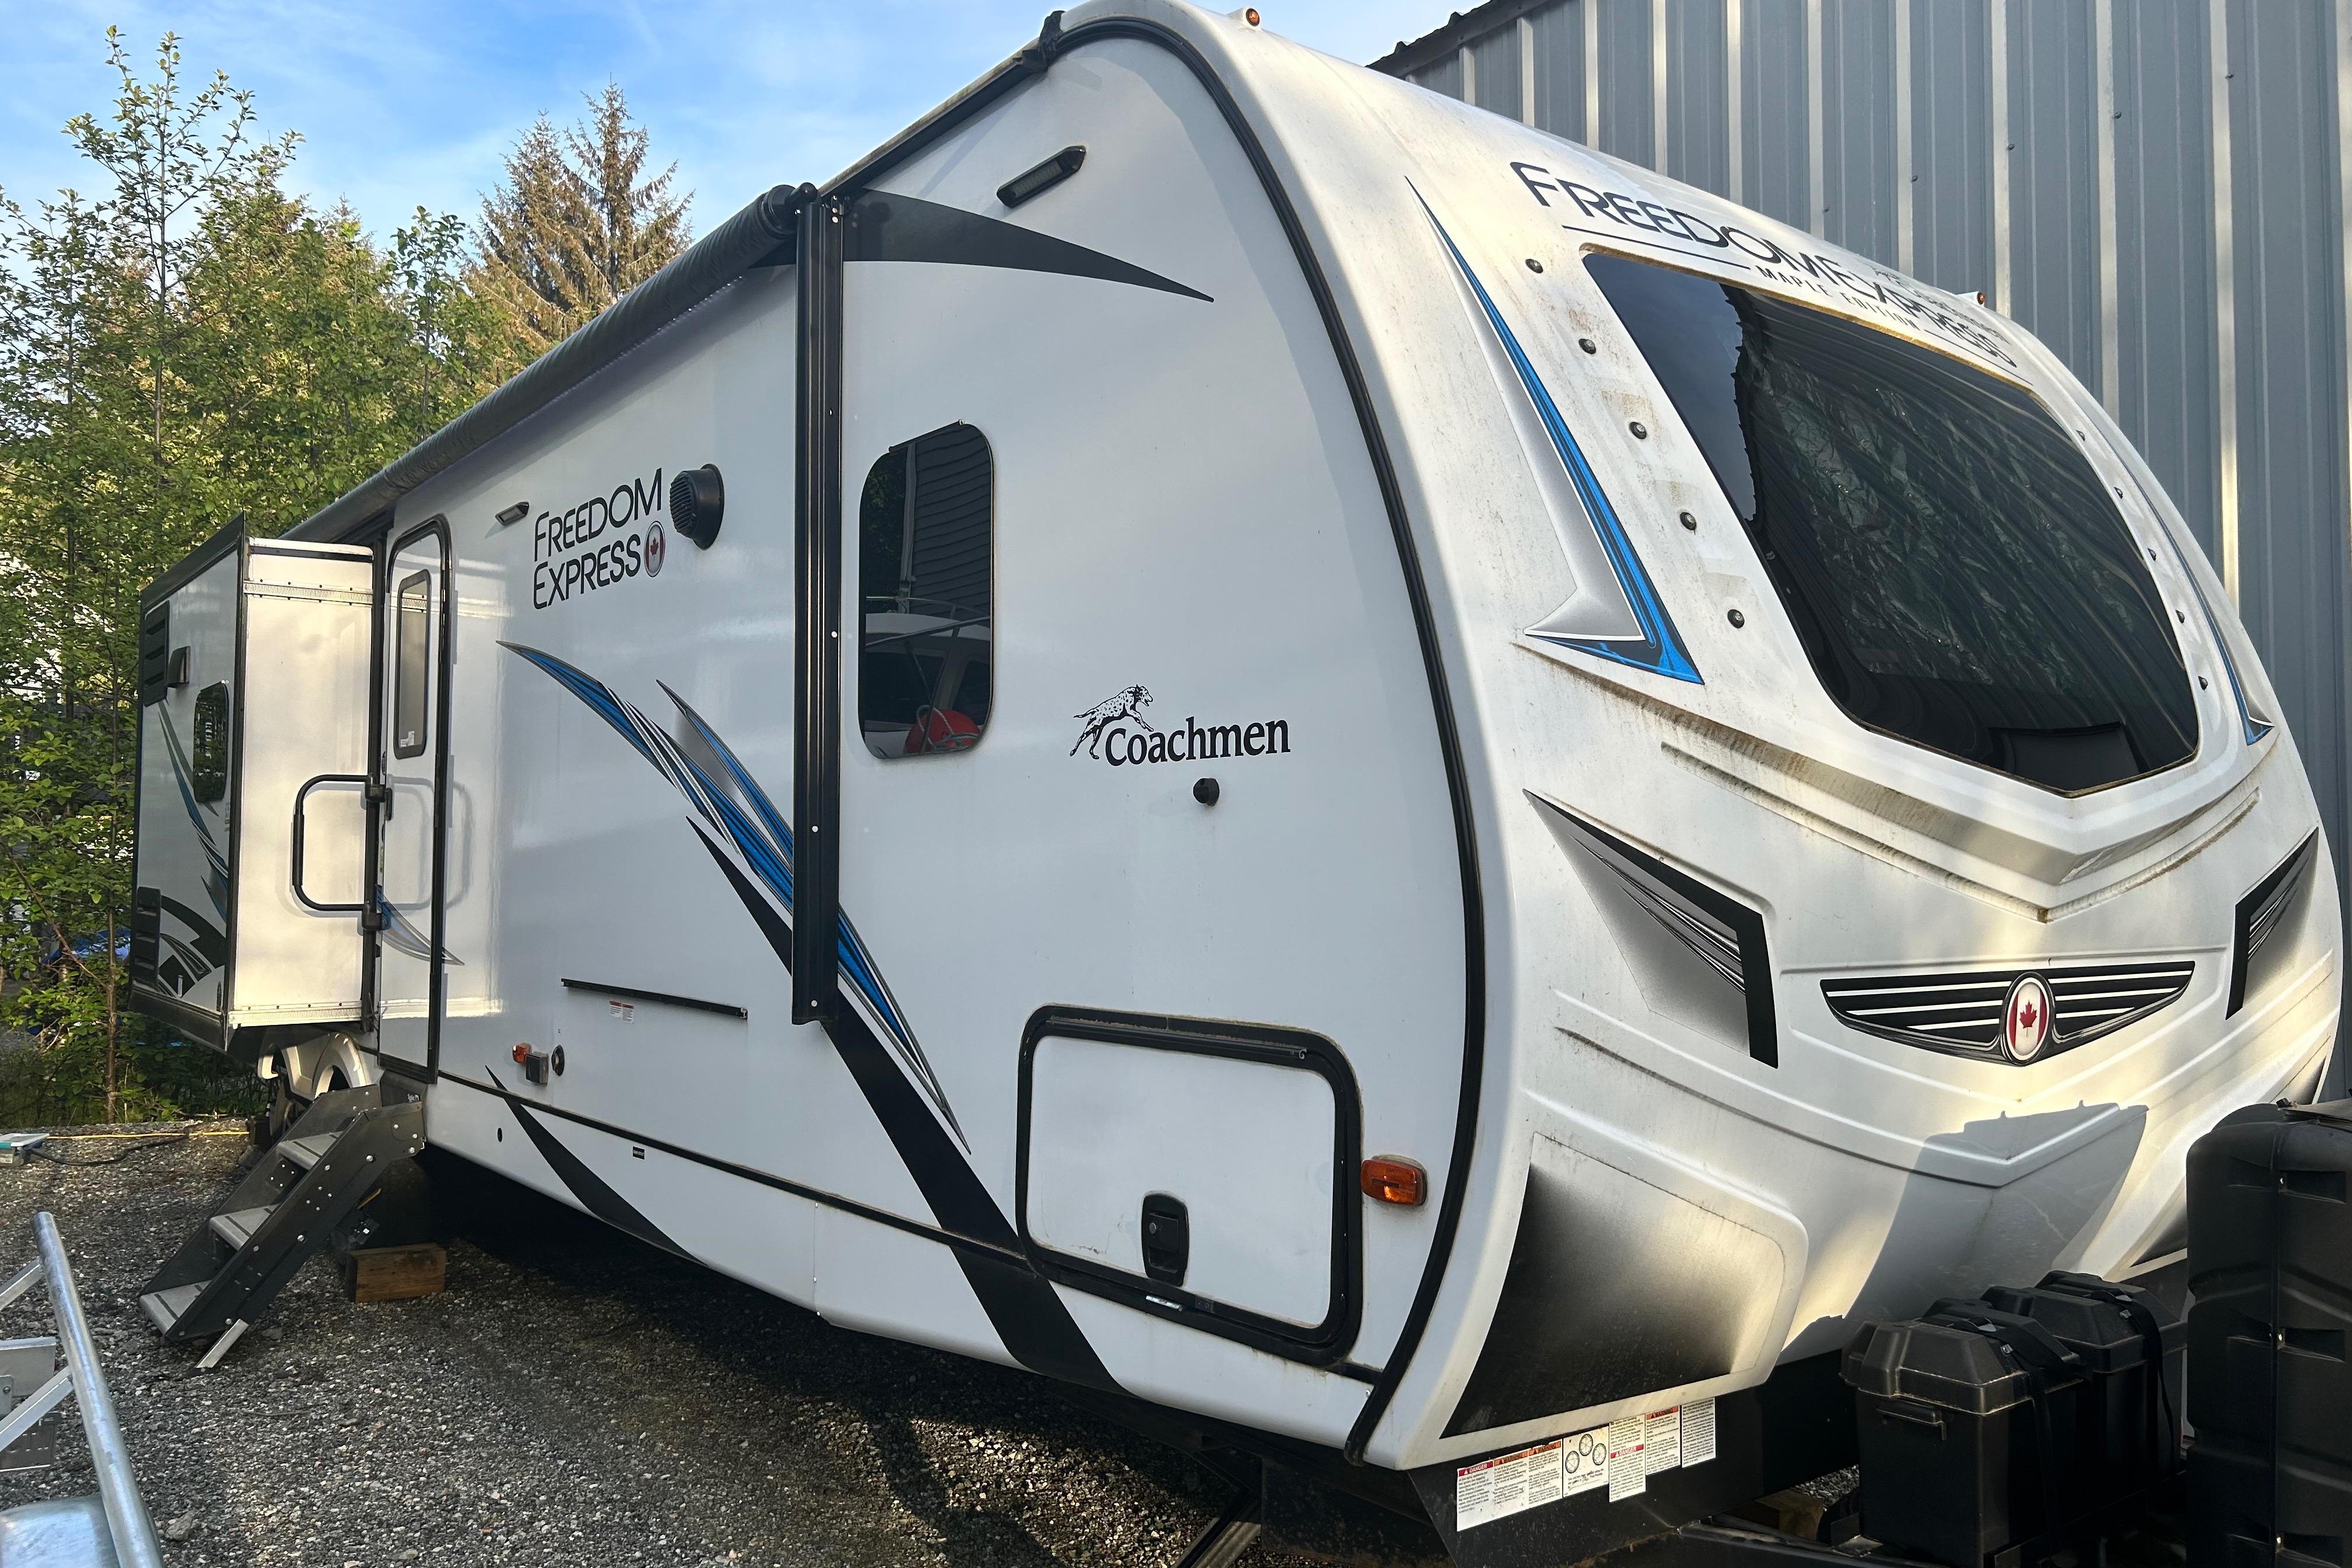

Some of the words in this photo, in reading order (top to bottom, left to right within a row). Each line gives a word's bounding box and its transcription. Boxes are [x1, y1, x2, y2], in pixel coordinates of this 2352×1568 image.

[1510, 162, 1839, 286] FREEDOM
[1815, 255, 2017, 368] EXPRESS
[1755, 265, 1833, 297] MAPLE
[534, 467, 662, 562] FREEDOM
[533, 533, 641, 610] EXPRESS
[1105, 716, 1291, 766] Coachmen
[1469, 1463, 1488, 1474] DANGER
[1619, 1446, 1637, 1456] DANGER
